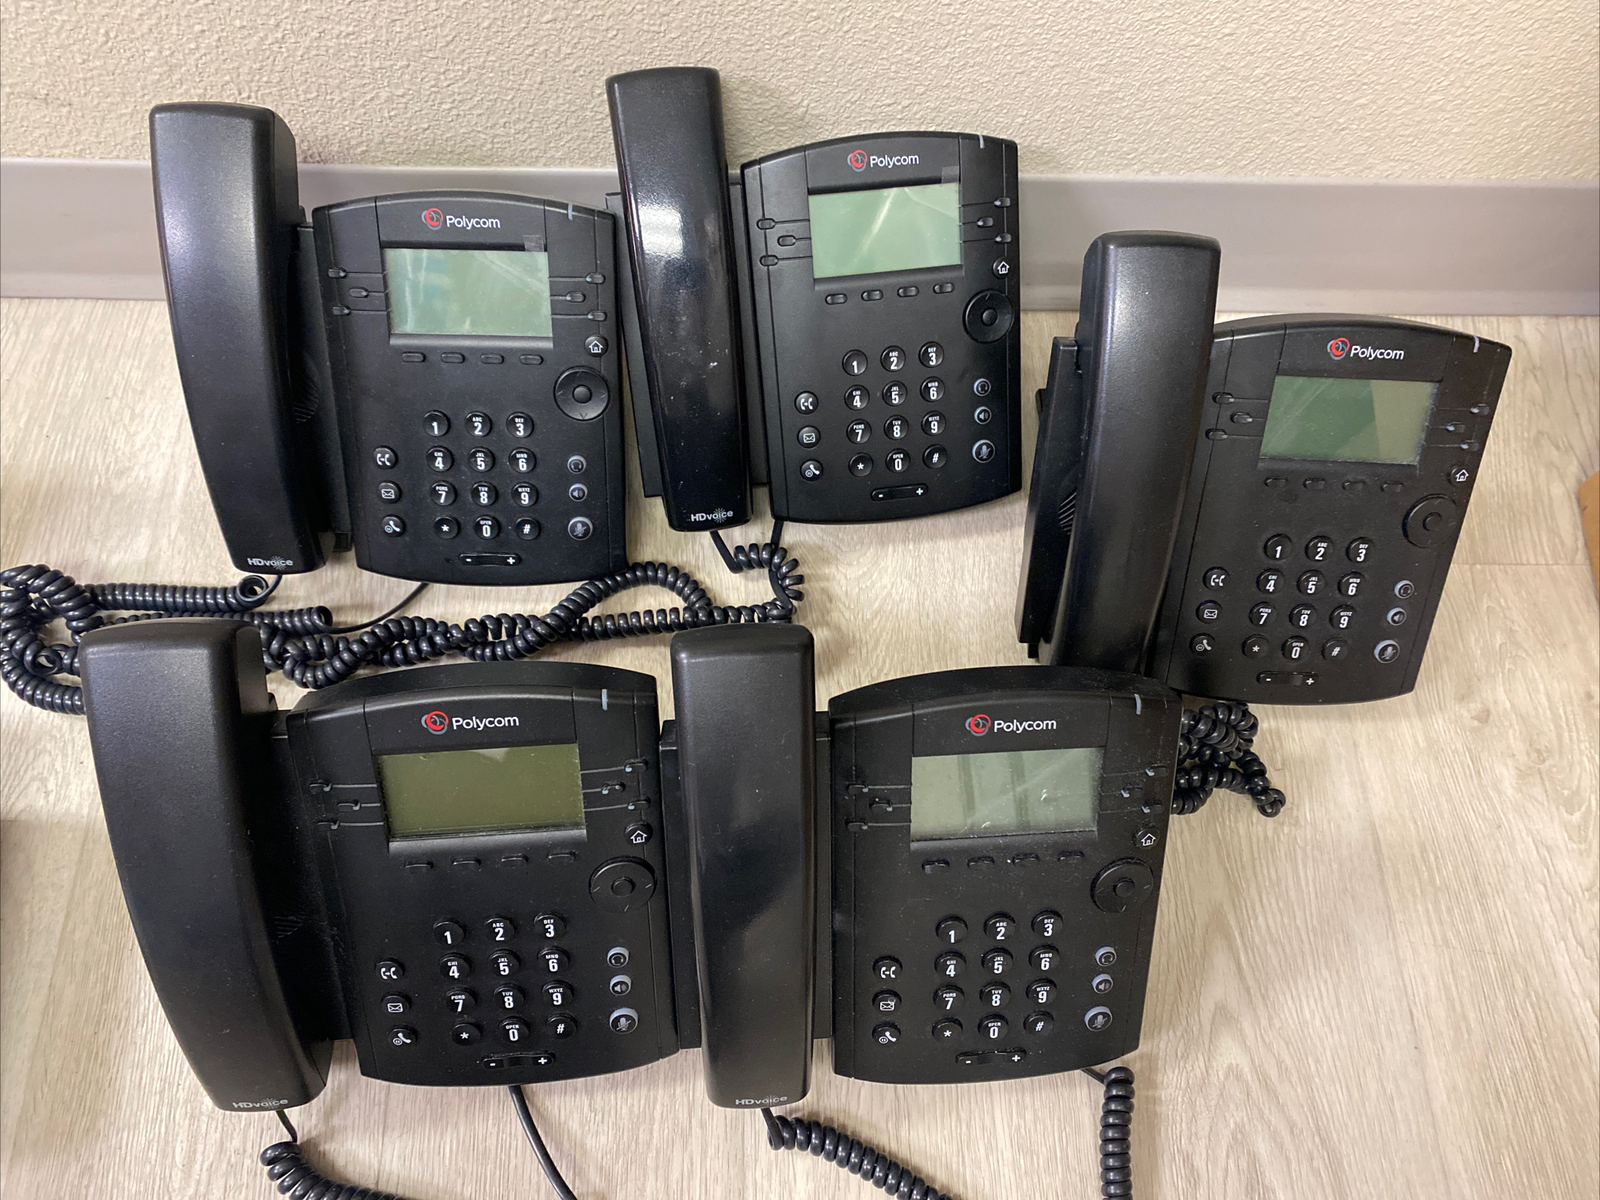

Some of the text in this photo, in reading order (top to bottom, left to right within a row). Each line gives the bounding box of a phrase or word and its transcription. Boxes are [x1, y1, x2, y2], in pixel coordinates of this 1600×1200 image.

[870, 155, 919, 168] Polycom
[446, 215, 500, 230] Polycom
[929, 353, 936, 365] 3
[1350, 346, 1404, 360] Polycom
[852, 361, 858, 373] 1
[890, 357, 898, 369] 2
[892, 391, 899, 404] 5
[930, 387, 937, 400] 6
[853, 396, 861, 408] 4
[432, 422, 438, 435] 1
[474, 422, 482, 435] 2
[516, 423, 524, 436] 3
[893, 425, 900, 437] 8
[931, 421, 938, 433] 9
[855, 429, 862, 441] 7
[435, 457, 444, 469] 4
[477, 458, 485, 470] 5
[519, 459, 527, 471] 6
[895, 459, 902, 471] 0
[438, 491, 446, 503] 7
[480, 491, 488, 504] 8
[521, 492, 529, 504] 9
[483, 525, 490, 537] 0
[1276, 546, 1281, 558] 1
[1315, 548, 1324, 560] 2
[1357, 549, 1366, 561] 3
[1266, 580, 1275, 592] 4
[1307, 582, 1316, 593] 5
[1348, 583, 1357, 595] 6
[1259, 613, 1268, 624] 7
[1299, 615, 1308, 626] 8
[1340, 616, 1348, 628] 9
[1292, 647, 1300, 658] 0
[452, 716, 519, 730] Polycom
[994, 720, 1056, 734] Polycom
[495, 928, 504, 941] 2
[545, 924, 554, 937] 3
[996, 927, 1005, 940] 2
[1044, 924, 1053, 936] 3
[444, 931, 451, 944] 1
[949, 930, 955, 943] 1
[499, 962, 509, 975] 5
[549, 959, 558, 972] 6
[994, 961, 1002, 973] 5
[1041, 958, 1050, 970] 6
[449, 966, 459, 978] 4
[946, 965, 955, 977] 4
[504, 996, 514, 1008] 8
[553, 993, 562, 1005] 9
[992, 994, 1000, 1006] 8
[1038, 991, 1047, 1003] 9
[454, 1000, 463, 1012] 7
[945, 998, 953, 1009] 7
[509, 1029, 518, 1041] 0
[990, 1027, 998, 1038] 0
